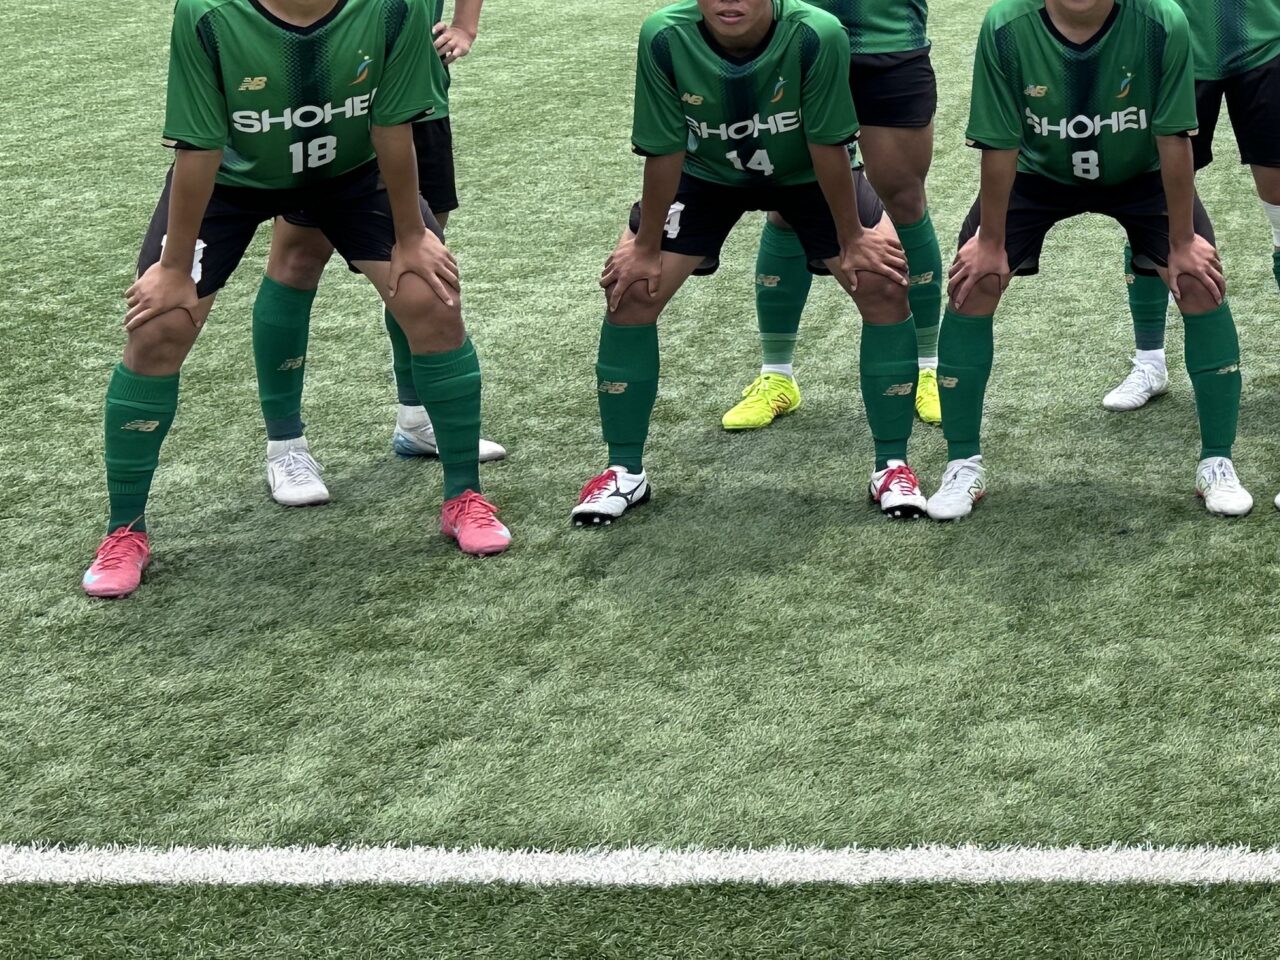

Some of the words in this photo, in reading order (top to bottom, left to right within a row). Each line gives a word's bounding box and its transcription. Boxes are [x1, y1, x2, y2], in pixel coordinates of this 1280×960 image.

[685, 107, 802, 141] SHOHE
[1025, 105, 1148, 140] SHOHEI
[289, 134, 338, 174] 18
[725, 149, 775, 176] 14
[1071, 149, 1100, 180] 8
